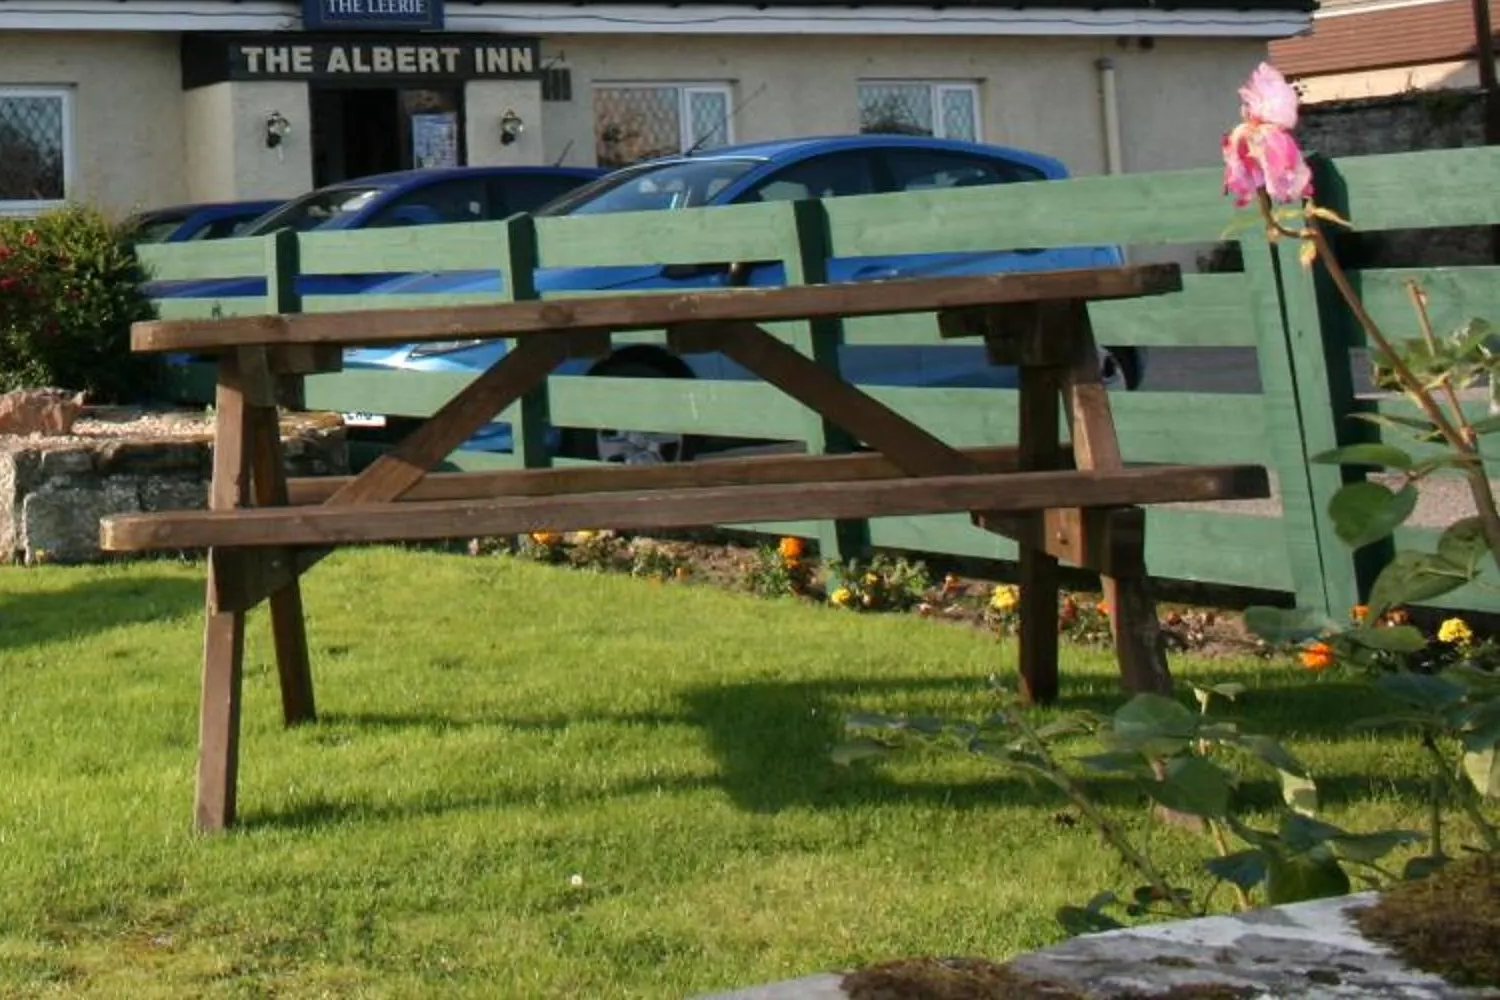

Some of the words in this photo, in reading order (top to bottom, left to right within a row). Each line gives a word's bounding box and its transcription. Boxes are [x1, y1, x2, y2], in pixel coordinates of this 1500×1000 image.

[241, 46, 314, 72] THE
[326, 47, 461, 72] ALBERT
[475, 48, 534, 73] INN
